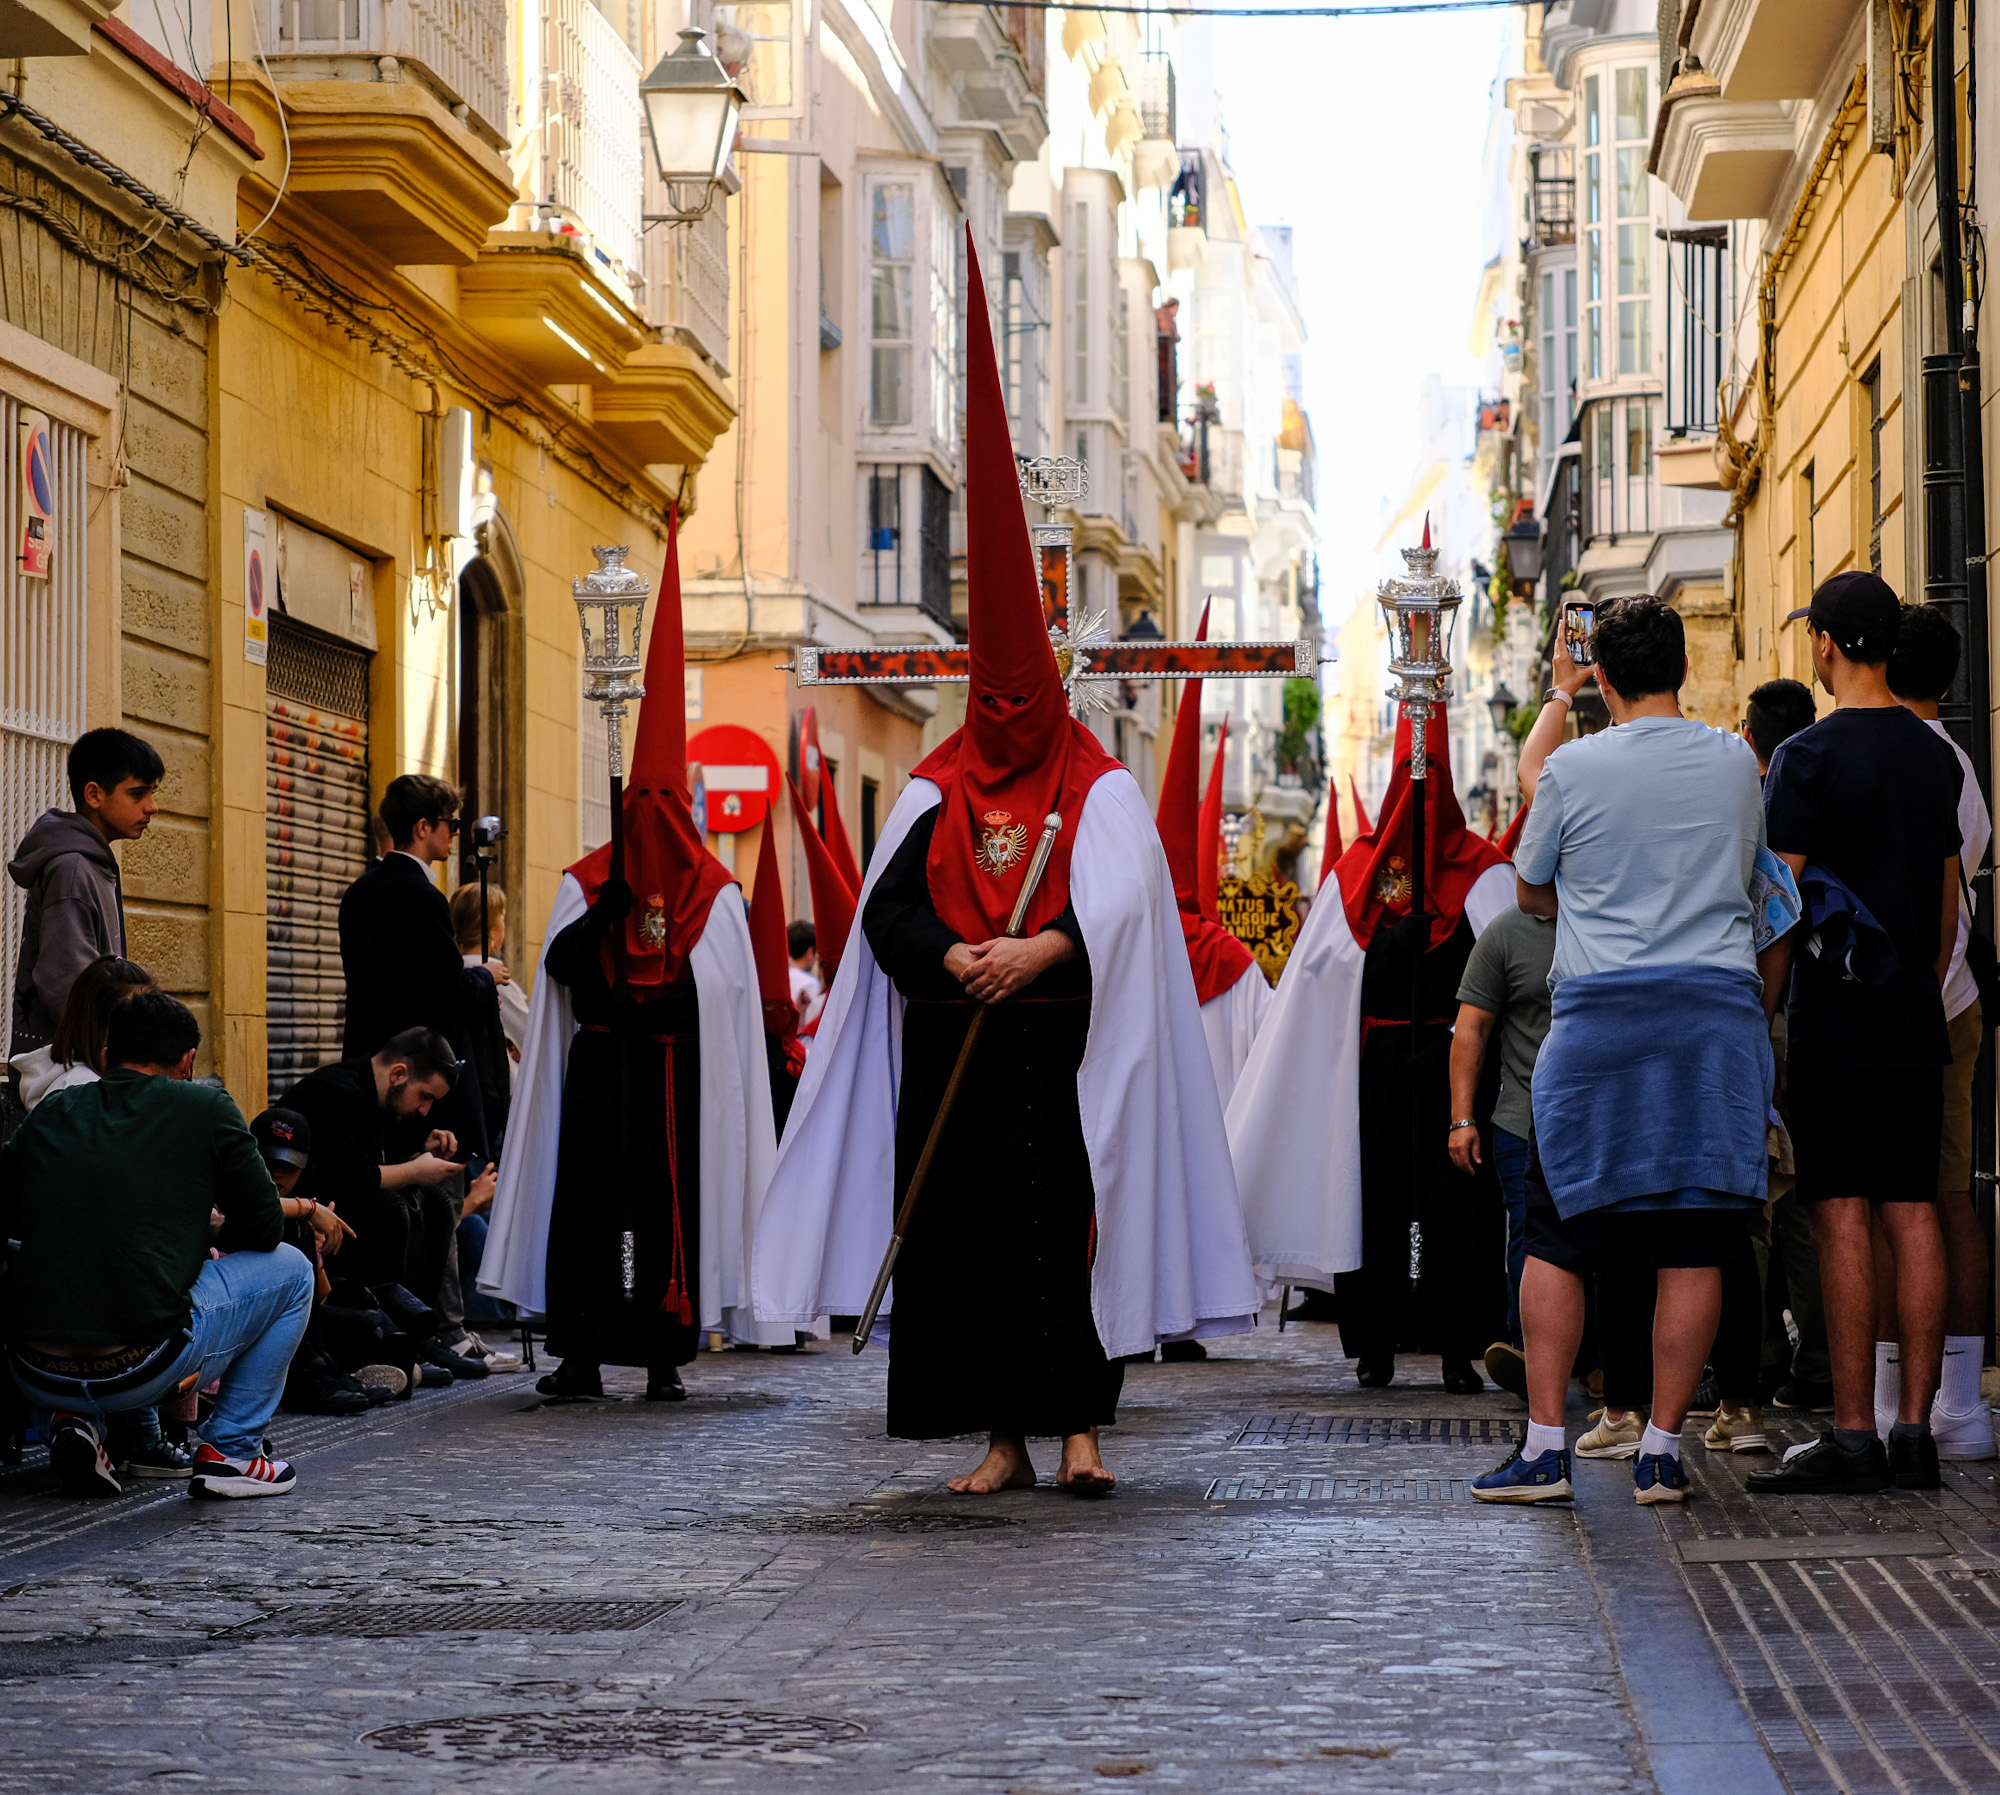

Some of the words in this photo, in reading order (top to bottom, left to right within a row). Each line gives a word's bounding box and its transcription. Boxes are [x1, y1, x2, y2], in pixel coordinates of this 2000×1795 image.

[1030, 468, 1077, 489] INRI
[1217, 898, 1265, 912] NATUS
[46, 1359, 80, 1373] ASS
